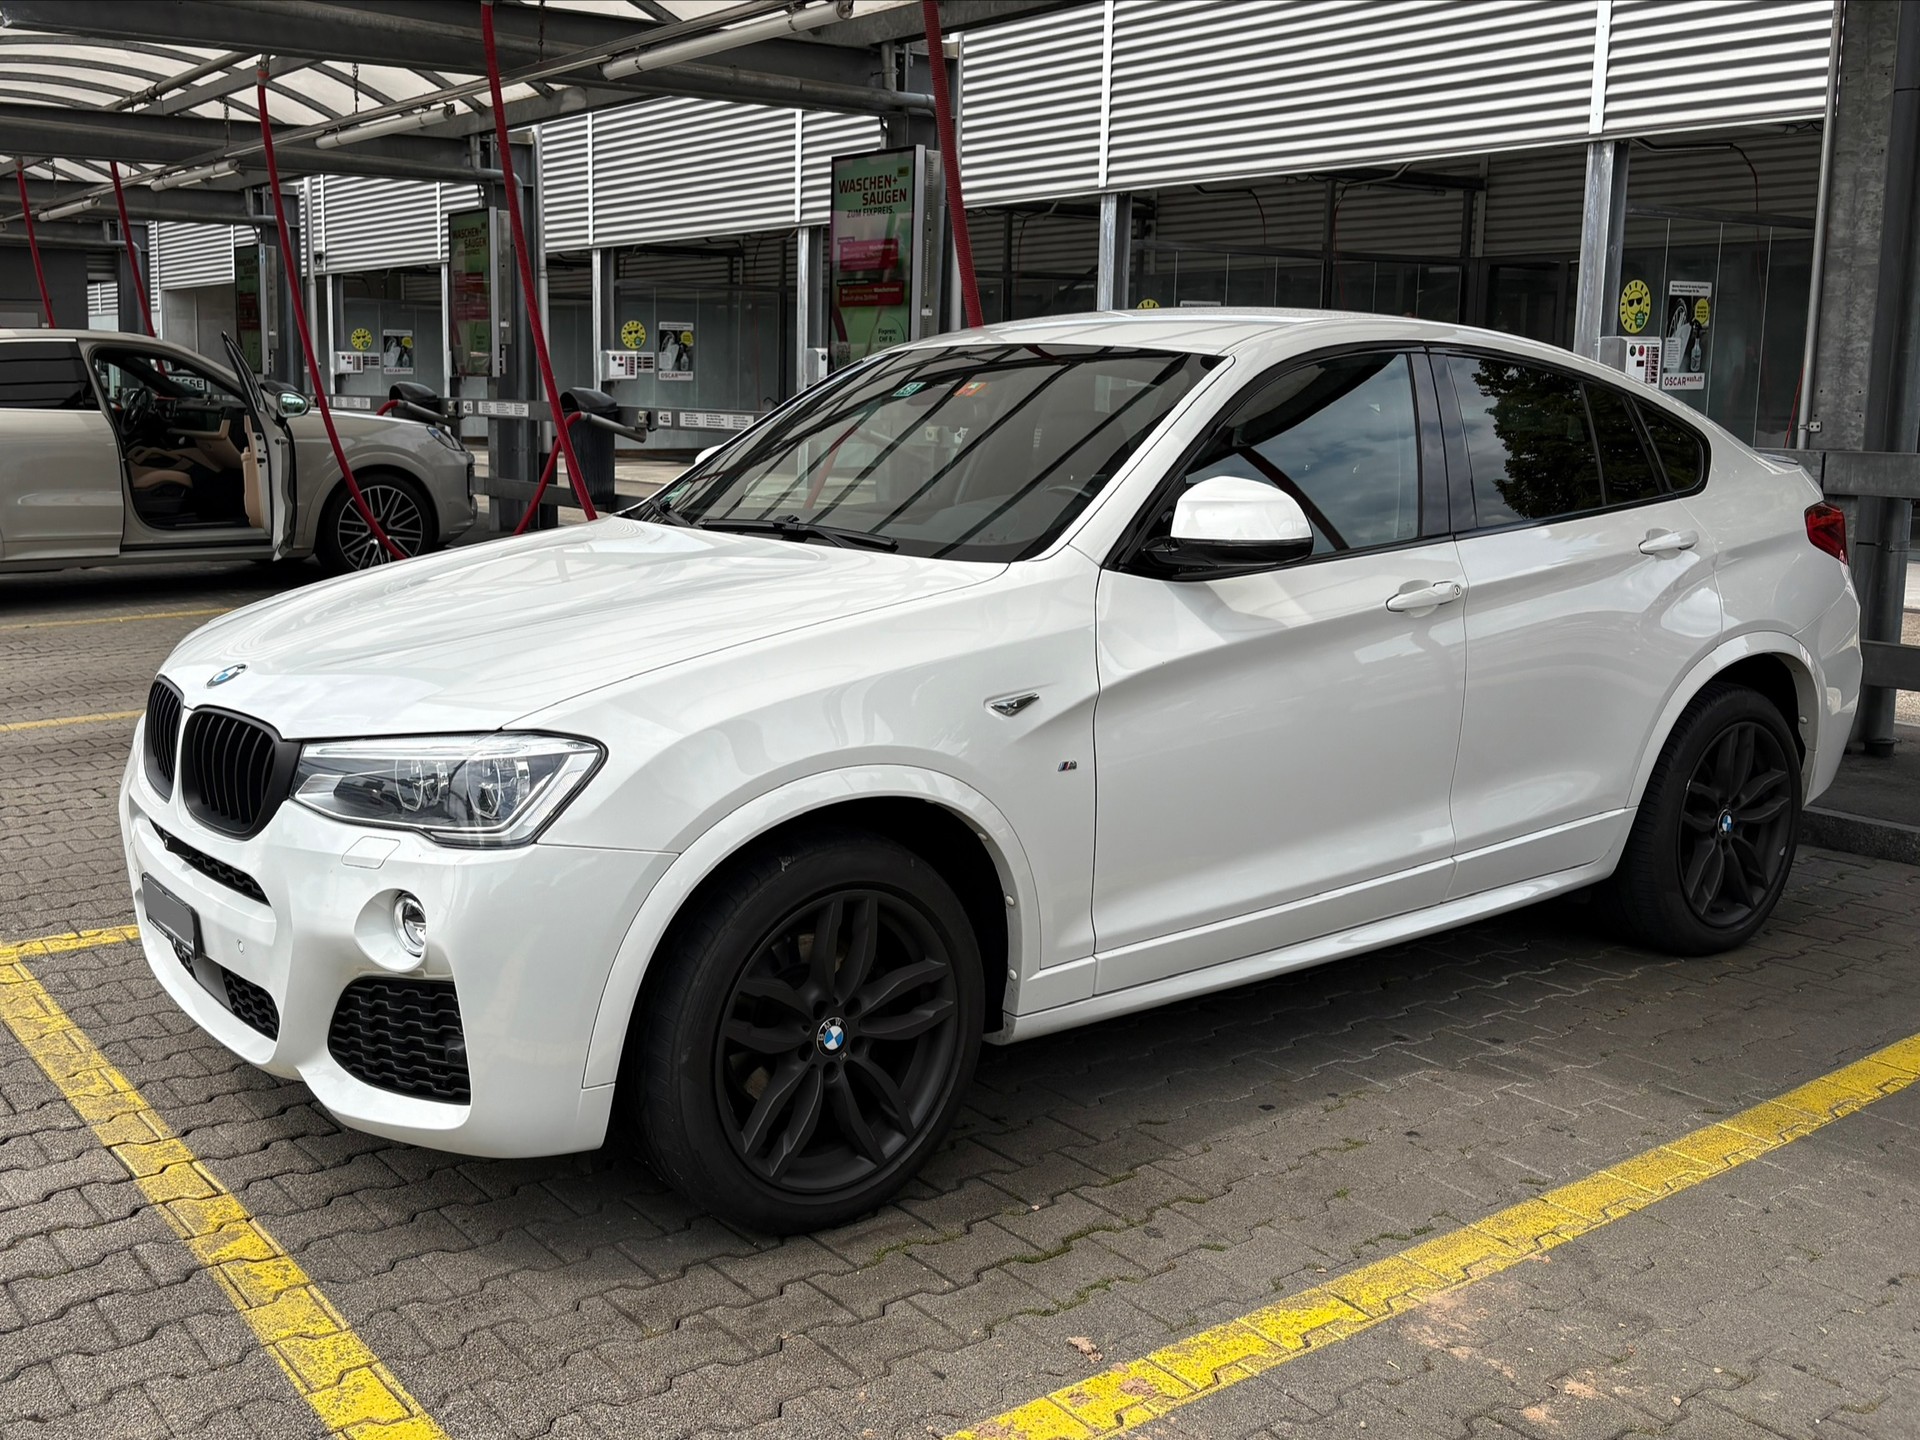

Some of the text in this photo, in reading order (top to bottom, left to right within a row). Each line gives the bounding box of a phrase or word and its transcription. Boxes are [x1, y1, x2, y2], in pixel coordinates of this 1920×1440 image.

[838, 174, 898, 194] WASCHEN+
[862, 188, 907, 206] SAUGEN
[847, 208, 862, 218] ZUM
[818, 1017, 842, 1041] BMW
